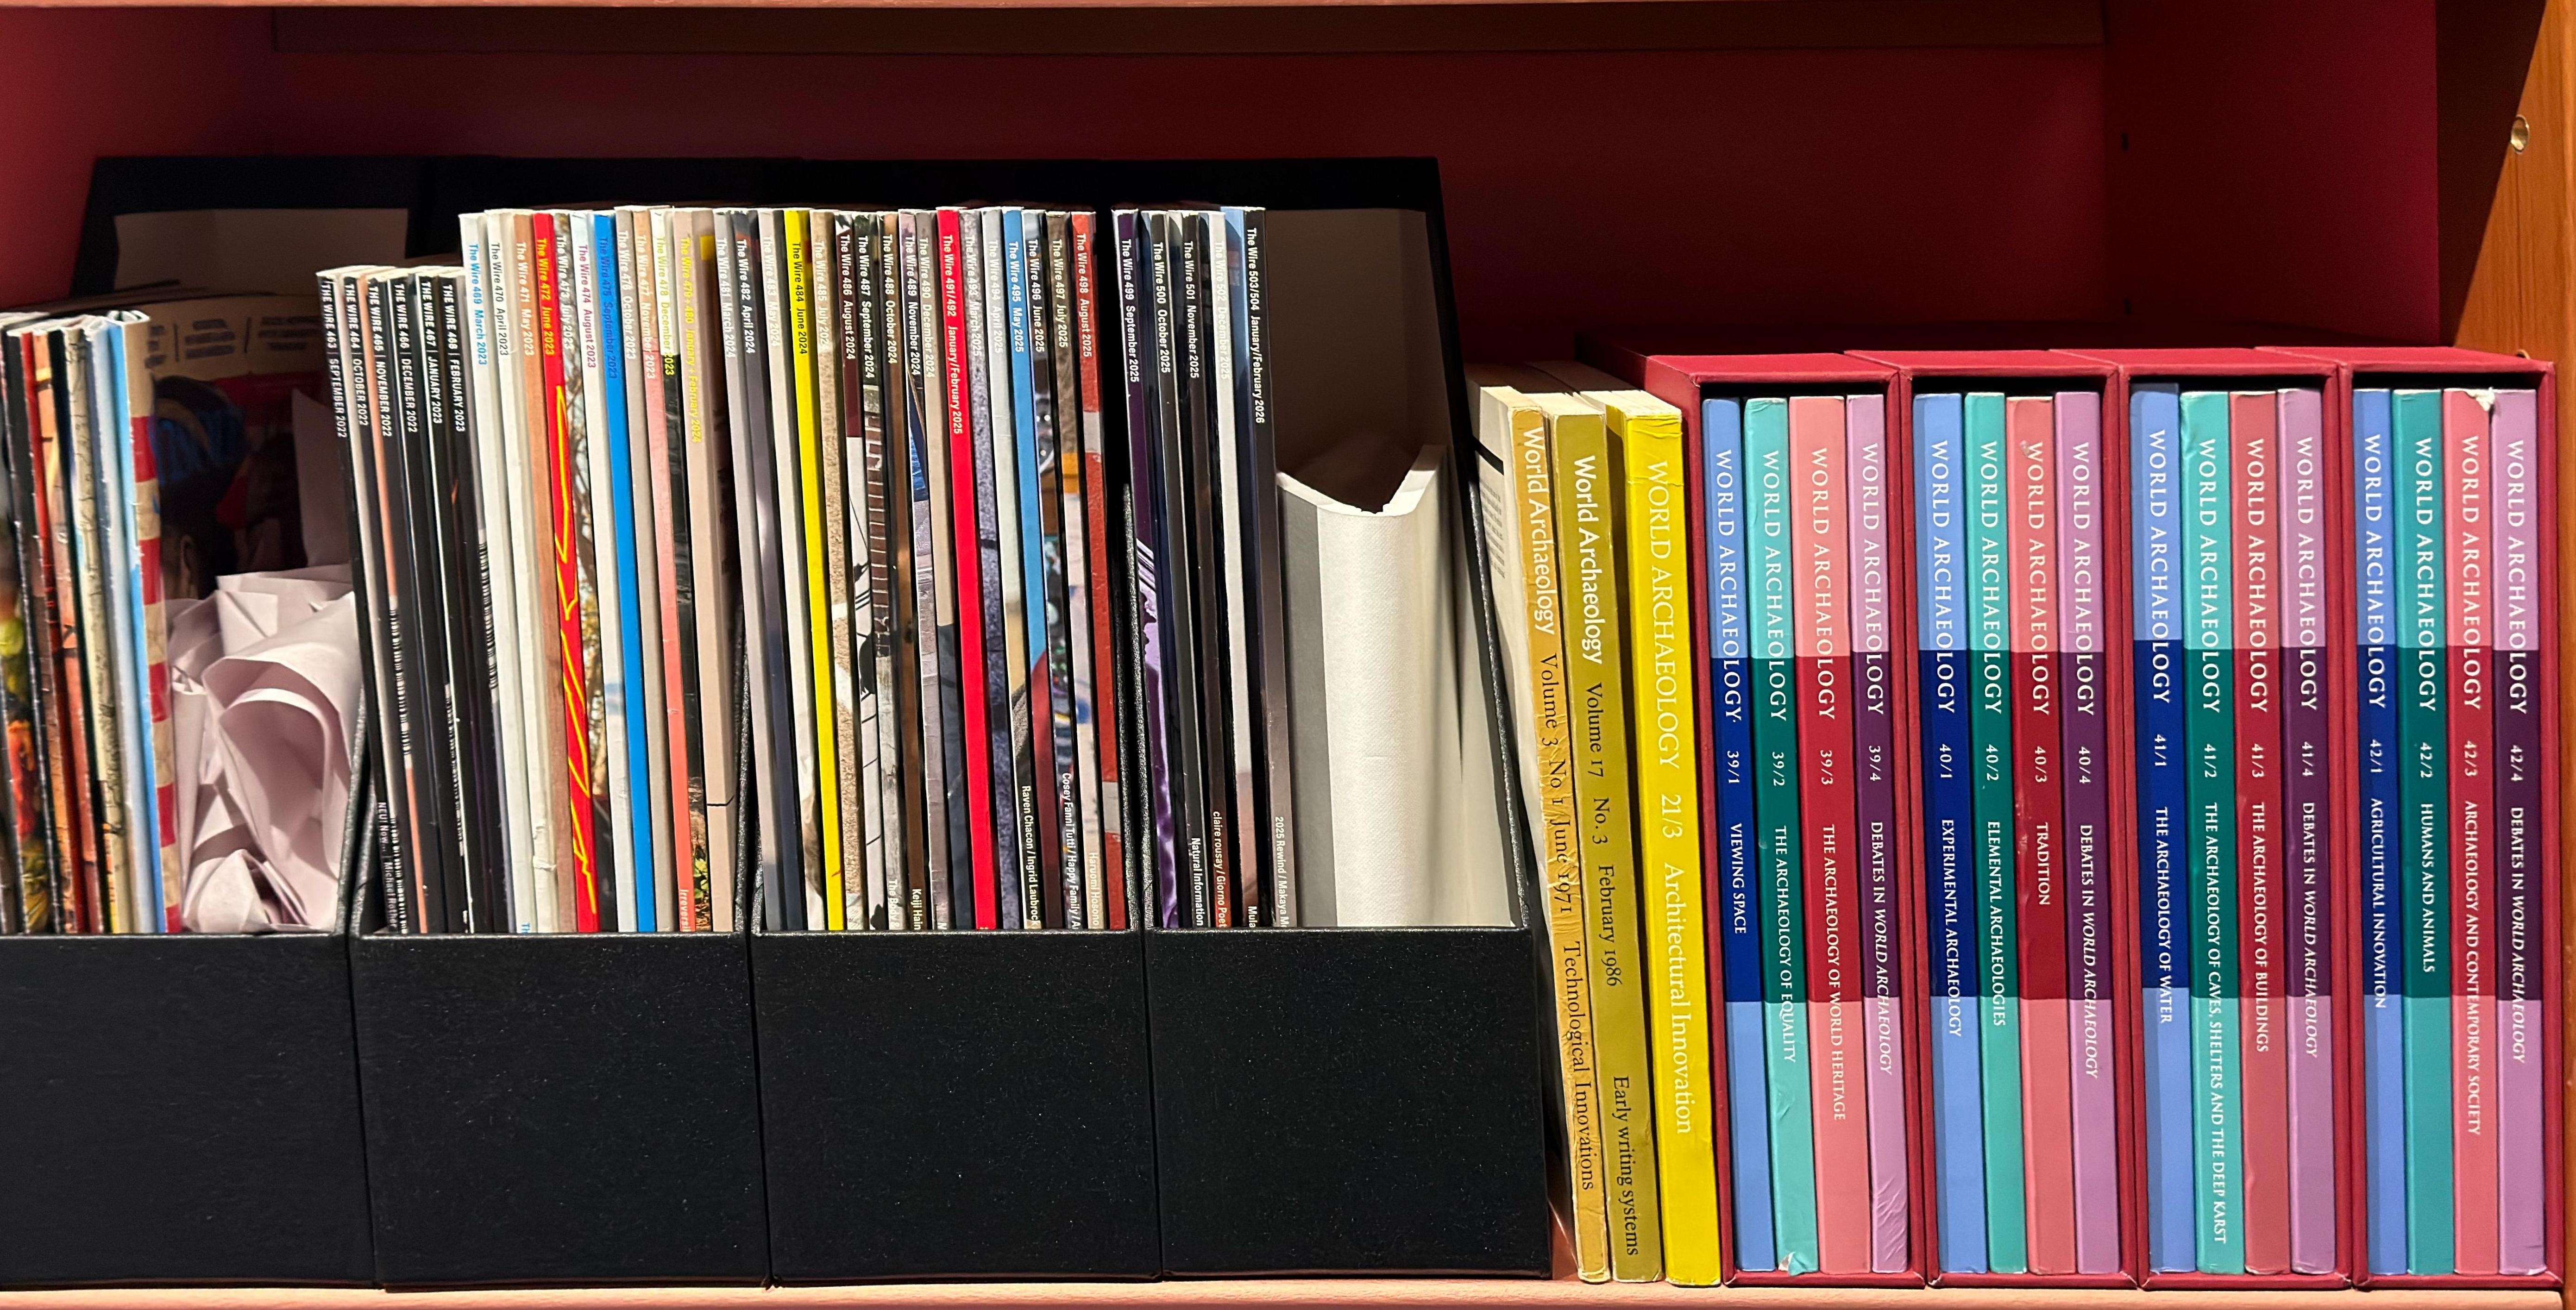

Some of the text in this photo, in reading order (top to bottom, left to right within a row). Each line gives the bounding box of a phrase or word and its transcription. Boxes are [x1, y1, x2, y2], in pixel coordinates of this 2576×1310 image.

[469, 244, 487, 365] The Wire 469 March 2023
[792, 242, 808, 354] The Wire 484 June 2024
[858, 236, 875, 378] The Wire 487 September 2024
[942, 235, 963, 434] The Wire 491/492 January/February 2025
[1121, 240, 1140, 382] The Wire 499 September 2025
[1247, 228, 1265, 423] The Wire 503/504 January/February 2026
[345, 284, 368, 425] THE WIRE 464 OCTOBER 2022
[1523, 427, 1549, 493] World
[1715, 450, 1735, 536] WORLD
[1527, 499, 1554, 634] Archaeology
[1539, 653, 1559, 729] Volume
[2027, 442, 2051, 905] WORLD ARCHAEOLOGY 40/3 TRADITION
[2415, 438, 2436, 972] WORLD ARCHAEOLOGY 42/2 HUMANS AND ANIMALS
[1542, 737, 1558, 746] 3
[1980, 441, 2006, 1026] WORLD ARCHAEOLOGY 40/2 ELEMENTAL ARCHAEOLOGIES
[2072, 442, 2098, 1079] WORLD ARCHAEOLOGY 40/4 DEBATES IN WORLD ARCHAEOLOGY
[2247, 439, 2269, 1052] WORLD ARCHAEOLOGY 41/3 THE ARCHAEOLOGY OF BUILDINGS
[2365, 435, 2387, 1008] WORLD ARCHAEOLOGY 42/1 AGRICULTURAL INNOVATION
[1022, 786, 1032, 813] Raven
[1061, 772, 1072, 800] Cosey
[1549, 759, 1566, 788] No
[1646, 462, 1695, 1134] WORLD ARCHAEOLOGY 21/3 Architectural Innovation
[1727, 750, 1740, 784] 39/1
[1811, 448, 1847, 1121] WORLD ARCHAEOLOGY 39/3 THE ARCHAEOLOGY OF WORLD HERITAGE
[2462, 436, 2481, 1135] WORLD ARCHAEOLOGY 42/3 ARCHAEOLOGY AND CONTEMPORARY SOCIETY
[1024, 815, 1034, 849] Chacon
[1065, 802, 1074, 827] Fanni
[1066, 828, 1075, 848] Tutti
[1213, 811, 1222, 836] claire
[1213, 839, 1223, 868] rousay
[1275, 817, 1284, 839] 2025
[2199, 439, 2226, 1244] WORLD ARCHAEOLOGY 41/2 THE ARCHAEOLOGY OF CAVES, SHELTERS AND THE DEEP KARST
[1027, 856, 1037, 882] Ingrid
[1066, 855, 1076, 884] Happy
[1192, 838, 1205, 926] Natural Information
[1216, 876, 1226, 906] Giorno
[1277, 840, 1286, 873] Rewind
[1553, 872, 1571, 914] 1971
[1574, 456, 1639, 1256] World Archaeology Volume 17 No. 3 February 1986 Early writing systems
[1730, 823, 1744, 889] VIEWING
[1029, 884, 1041, 925] Laubrock
[1068, 885, 1080, 914] Family
[1278, 881, 1287, 915] Makaya
[1733, 893, 1747, 934] SPACE
[1563, 941, 1590, 1073] Technological
[1574, 1082, 1596, 1191] Innovations
